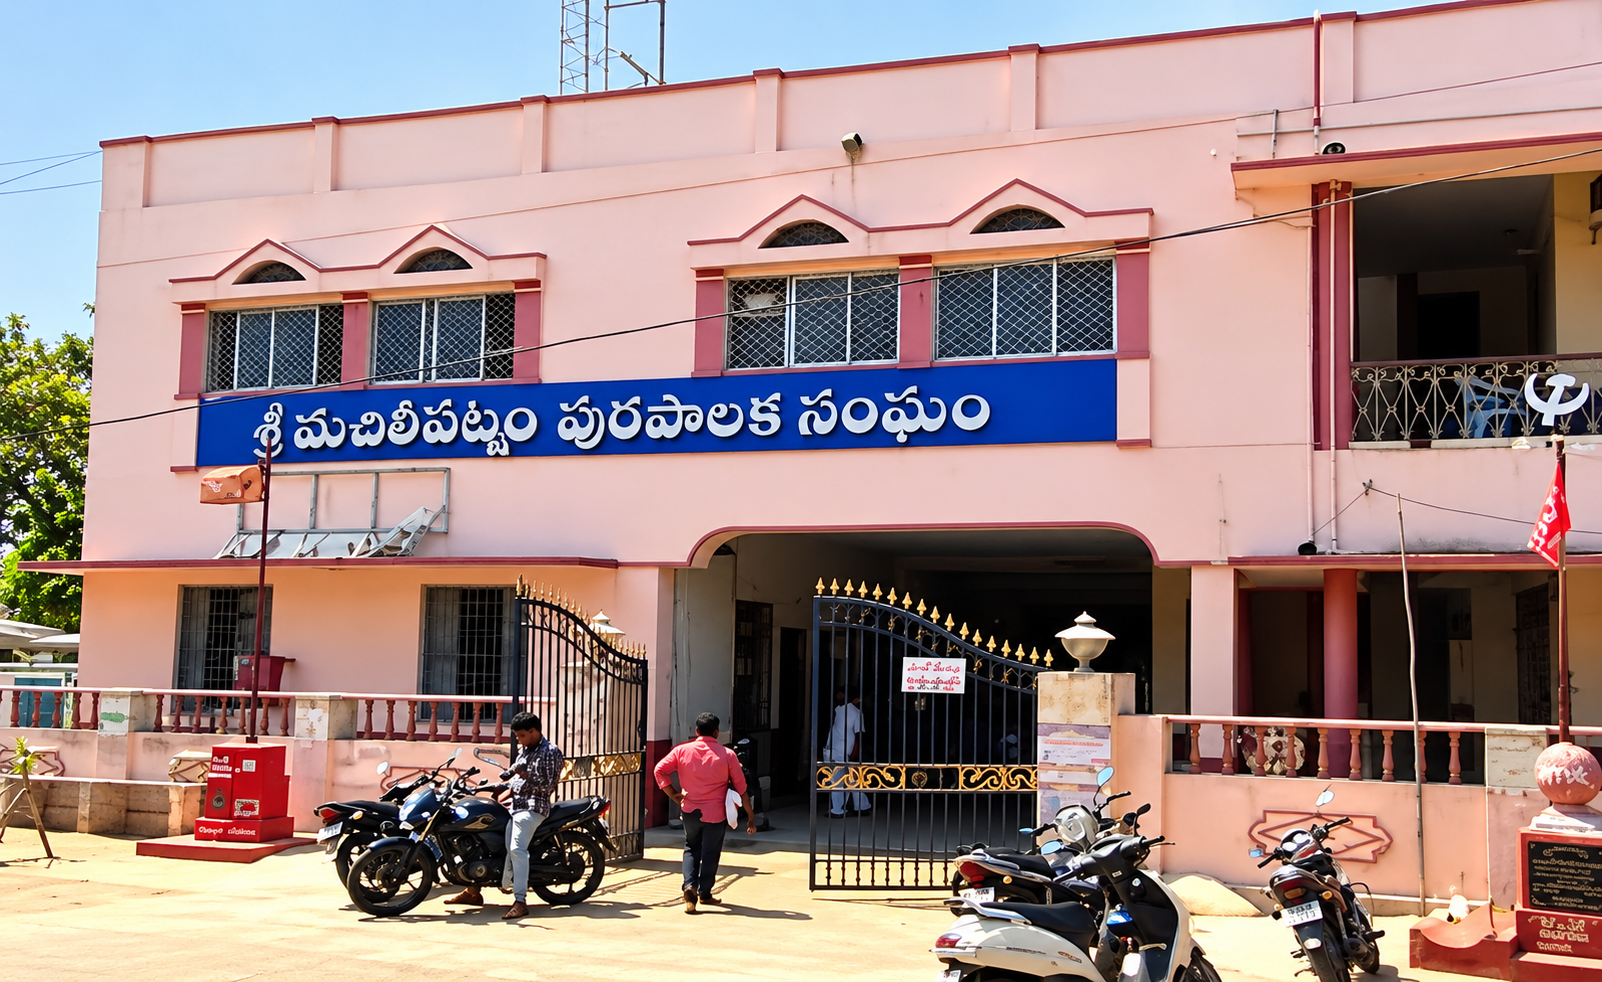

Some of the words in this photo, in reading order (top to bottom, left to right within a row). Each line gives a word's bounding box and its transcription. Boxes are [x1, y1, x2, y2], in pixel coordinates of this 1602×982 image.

[253, 402, 283, 458] శ్రీ
[557, 394, 782, 450] పురపాలక
[798, 385, 991, 442] సంఘం
